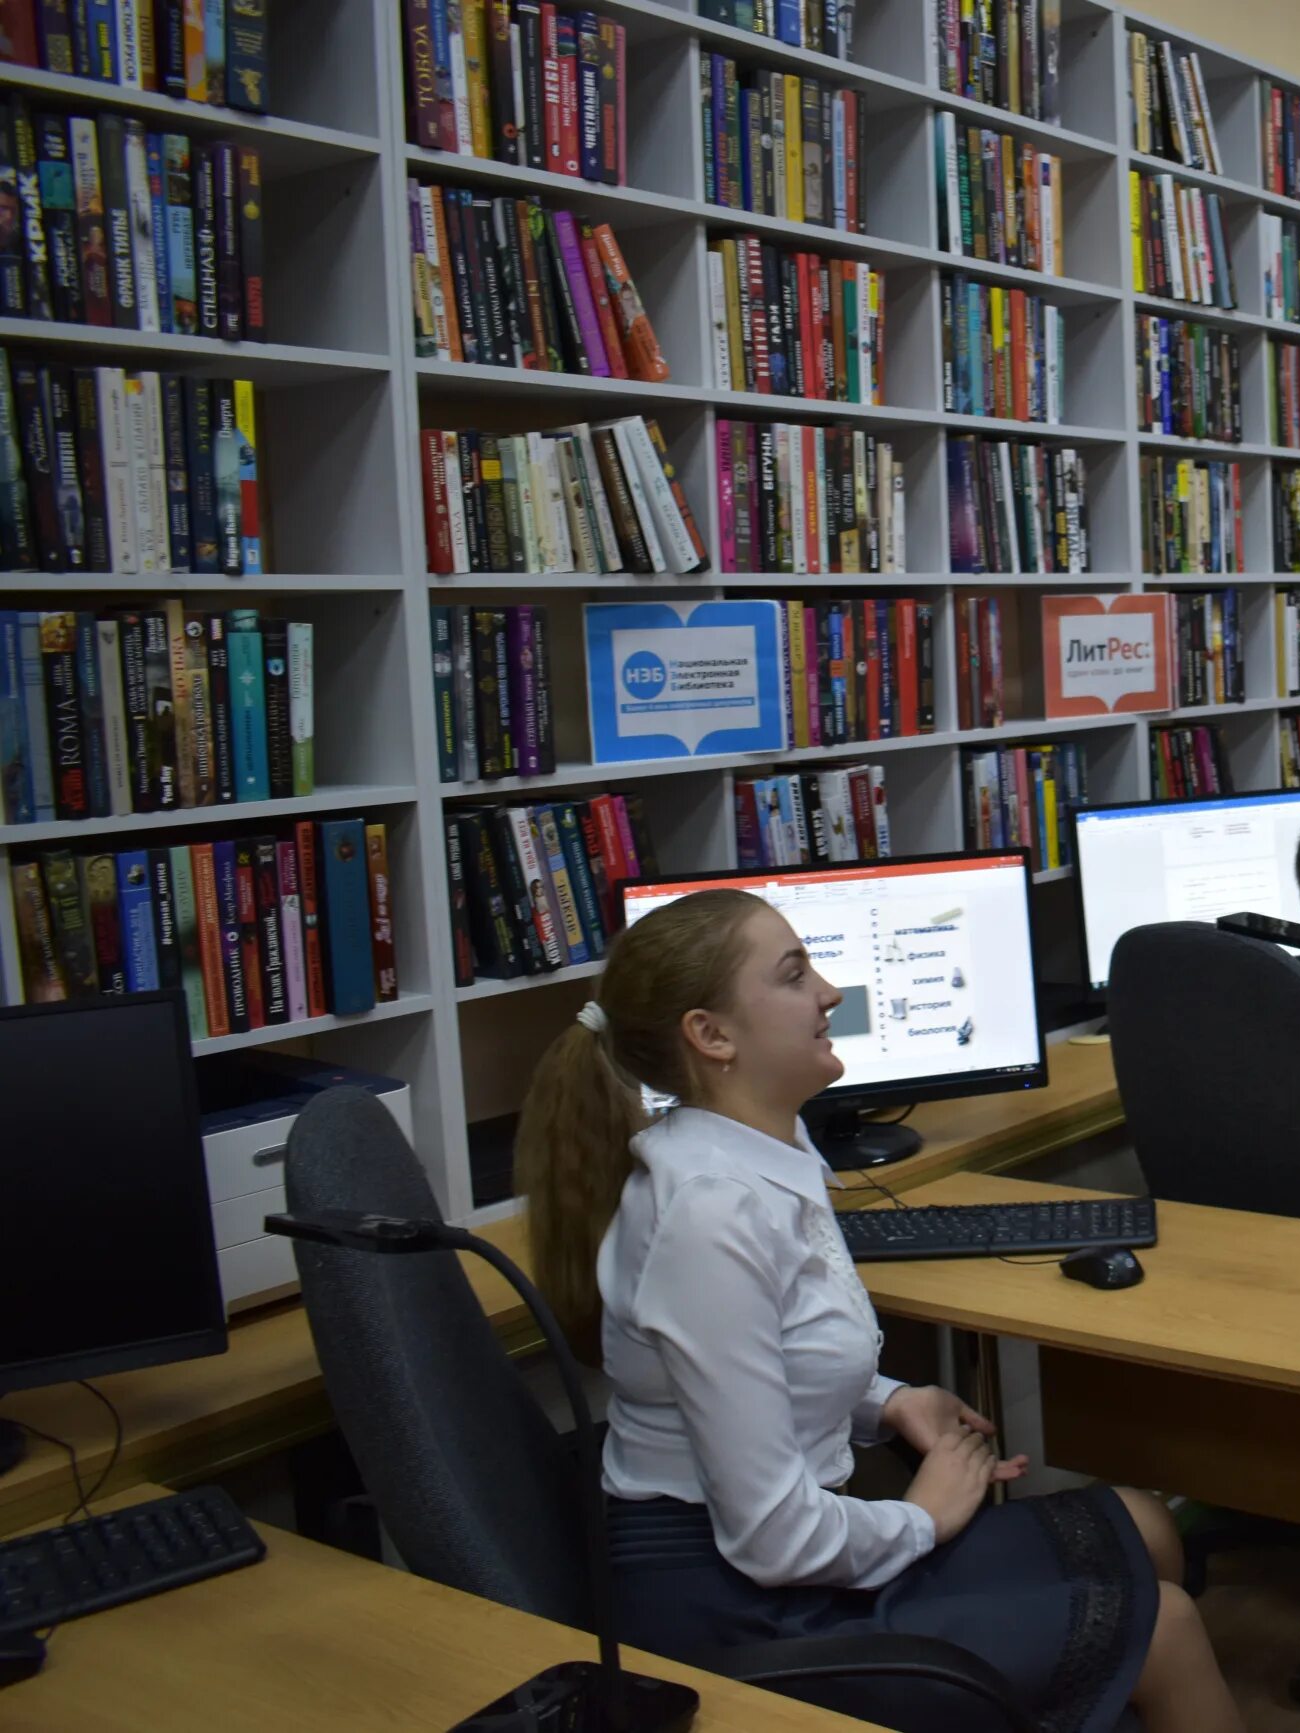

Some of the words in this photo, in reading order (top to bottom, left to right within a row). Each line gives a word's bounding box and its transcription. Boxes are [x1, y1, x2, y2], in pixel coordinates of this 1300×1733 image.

[415, 24, 434, 107] ТОБОЛ
[544, 60, 560, 103] НЕБО
[583, 71, 597, 148] ЧИСТИЛЬЩИК
[111, 209, 129, 255] ТИЛЬЕ
[117, 259, 134, 308] ФРАНК
[200, 247, 218, 328] СПЕЦНАЗ
[761, 433, 774, 490] БЕГУНЫ
[626, 667, 664, 683] НЭБ
[669, 657, 748, 669] Национальная
[670, 669, 740, 681] Электронная
[671, 681, 734, 692] Библиотека
[57, 698, 80, 766] ROMA
[156, 863, 173, 945] #черная_полка
[908, 949, 945, 960] физика
[228, 948, 245, 1016] ПРОВОДНИК
[268, 973, 284, 997] полях
[912, 974, 944, 985] химия
[270, 999, 284, 1014] На
[909, 1000, 951, 1011] история
[908, 1024, 956, 1037] биология
